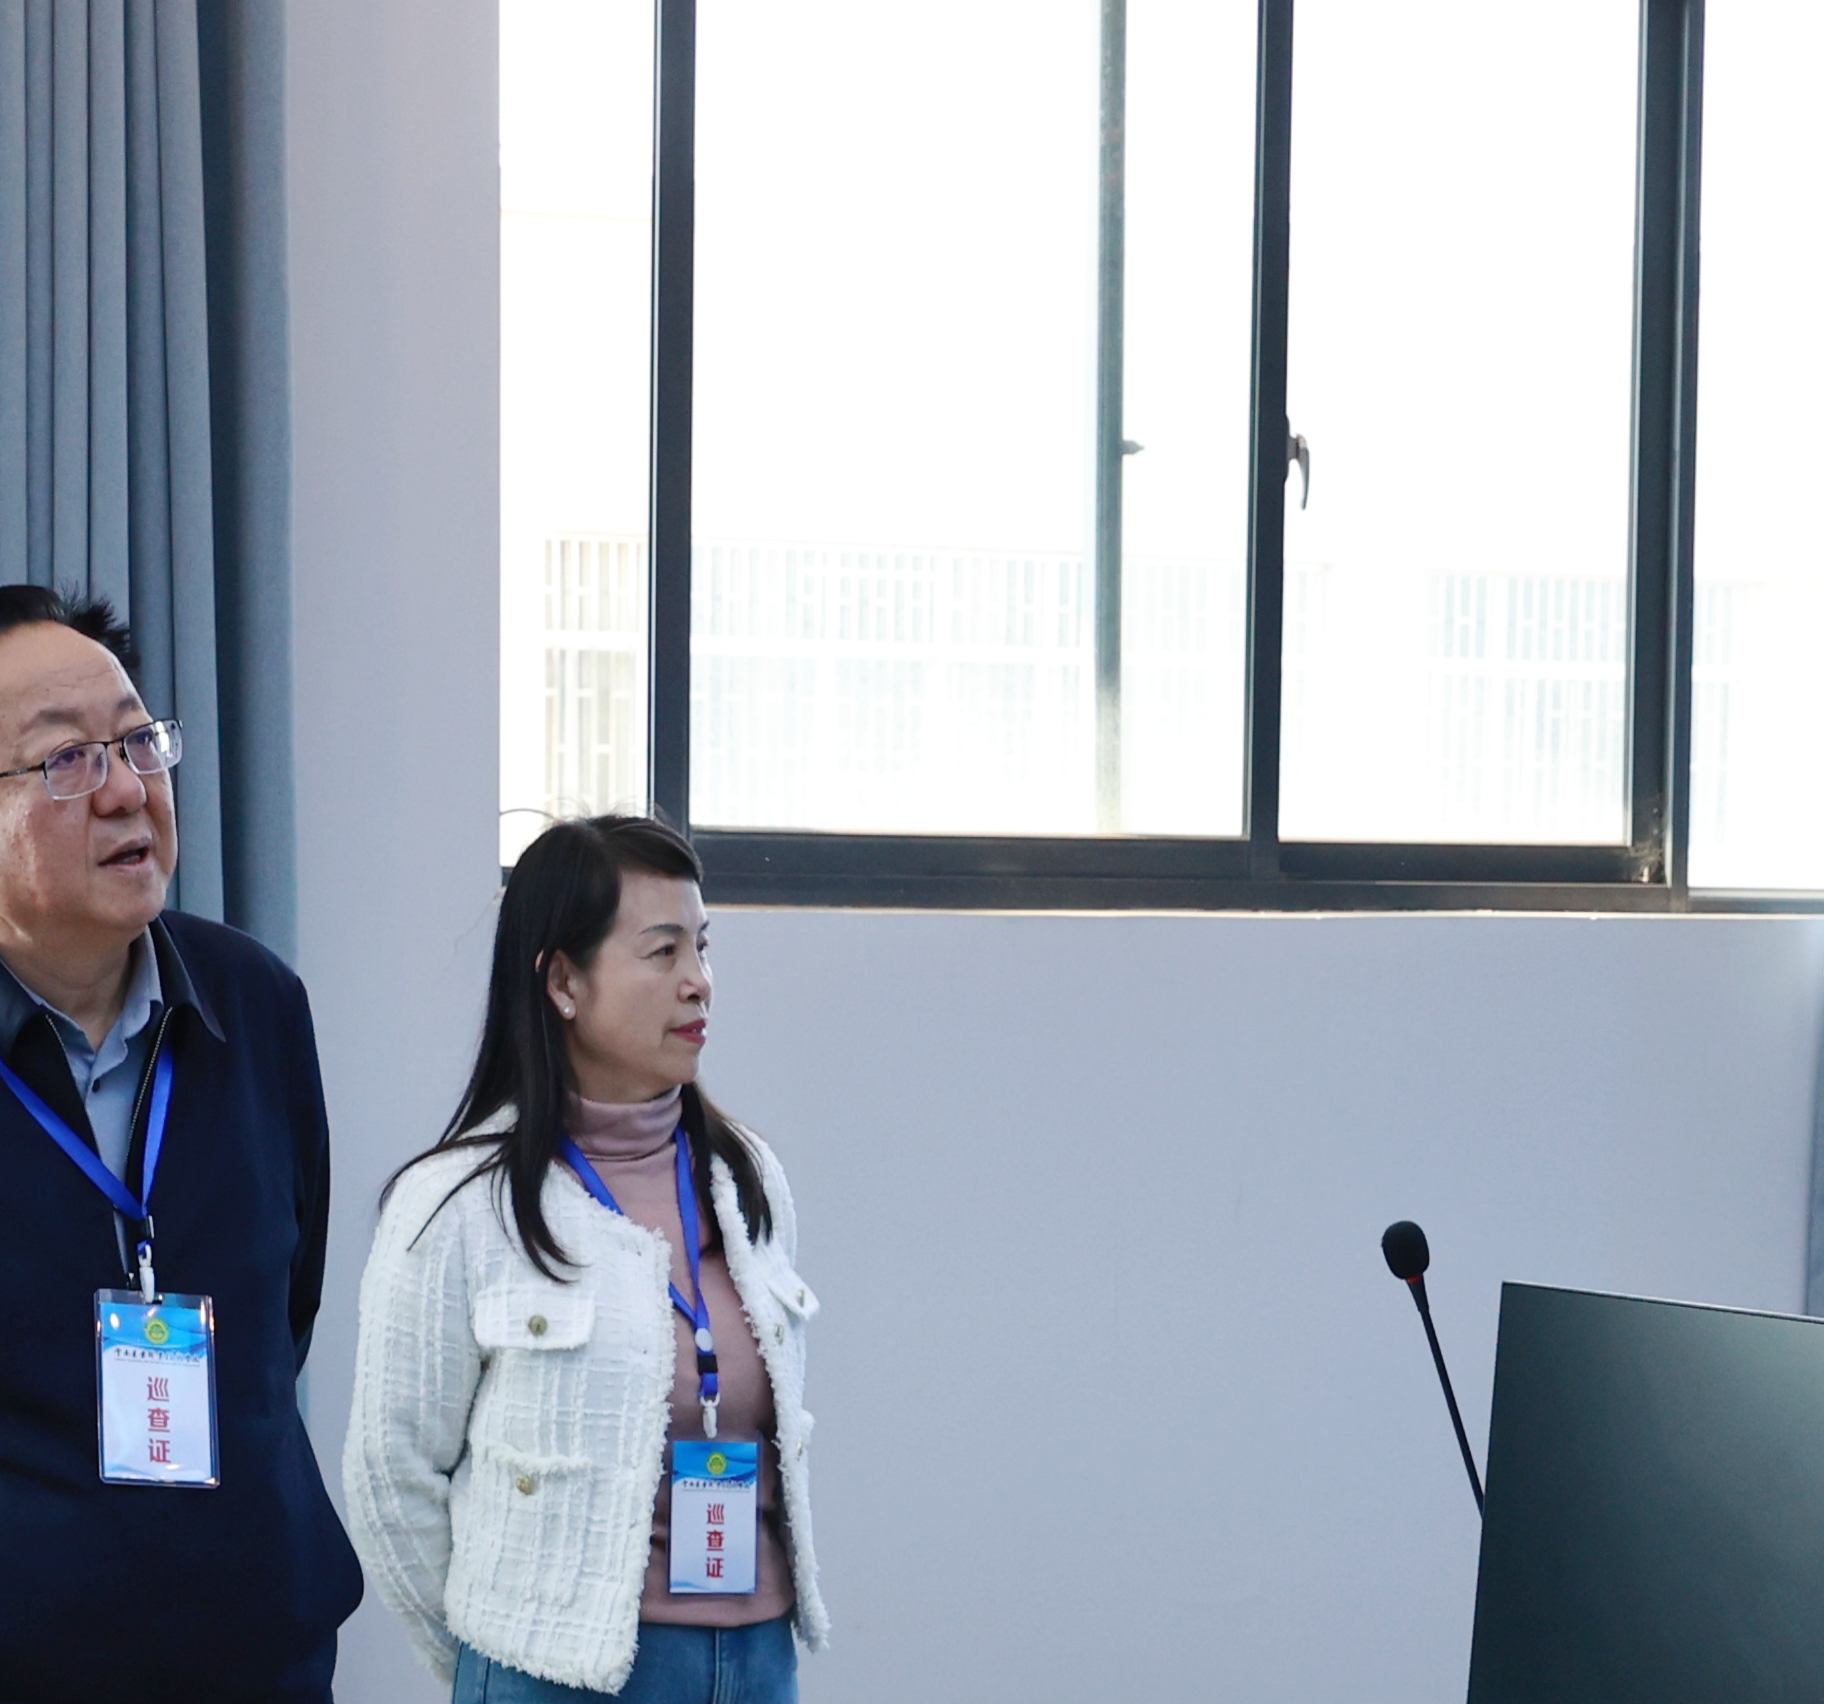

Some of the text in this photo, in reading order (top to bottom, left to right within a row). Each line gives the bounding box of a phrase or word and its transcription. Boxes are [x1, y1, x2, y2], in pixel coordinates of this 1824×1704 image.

[146, 1376, 172, 1464] 巡查证
[705, 1503, 725, 1579] 巡查证
